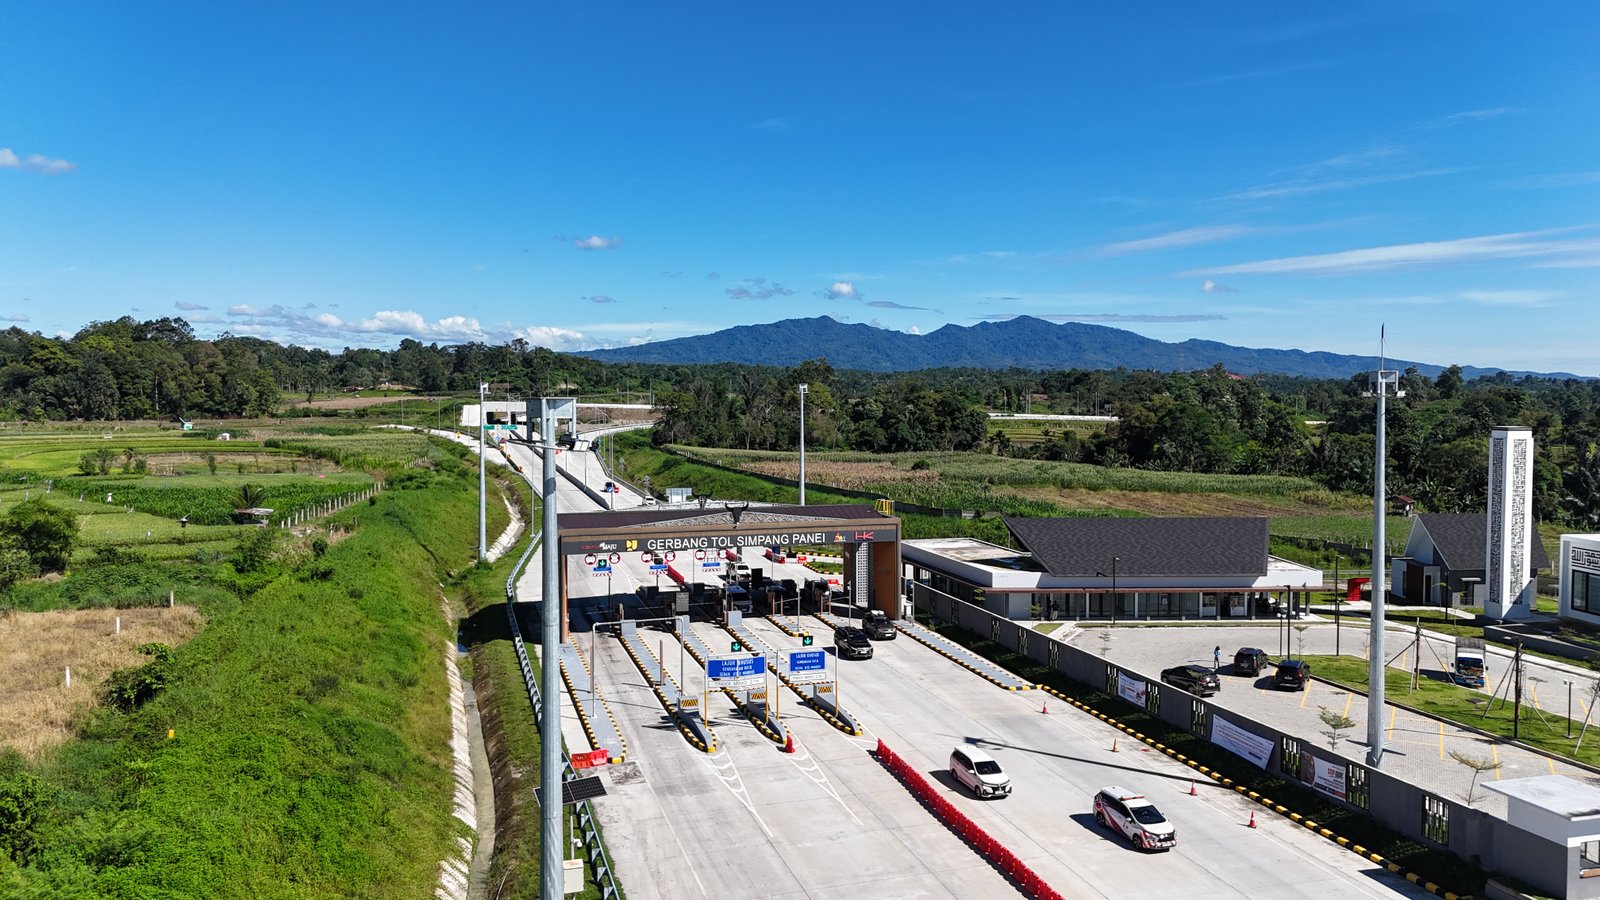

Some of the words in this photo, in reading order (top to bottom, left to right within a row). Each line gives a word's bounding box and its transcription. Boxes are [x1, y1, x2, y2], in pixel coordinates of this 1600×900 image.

[647, 537, 708, 550] GERBANG
[711, 537, 734, 547] TOL
[736, 535, 789, 546] SIMPANG
[792, 533, 825, 544] PANEI
